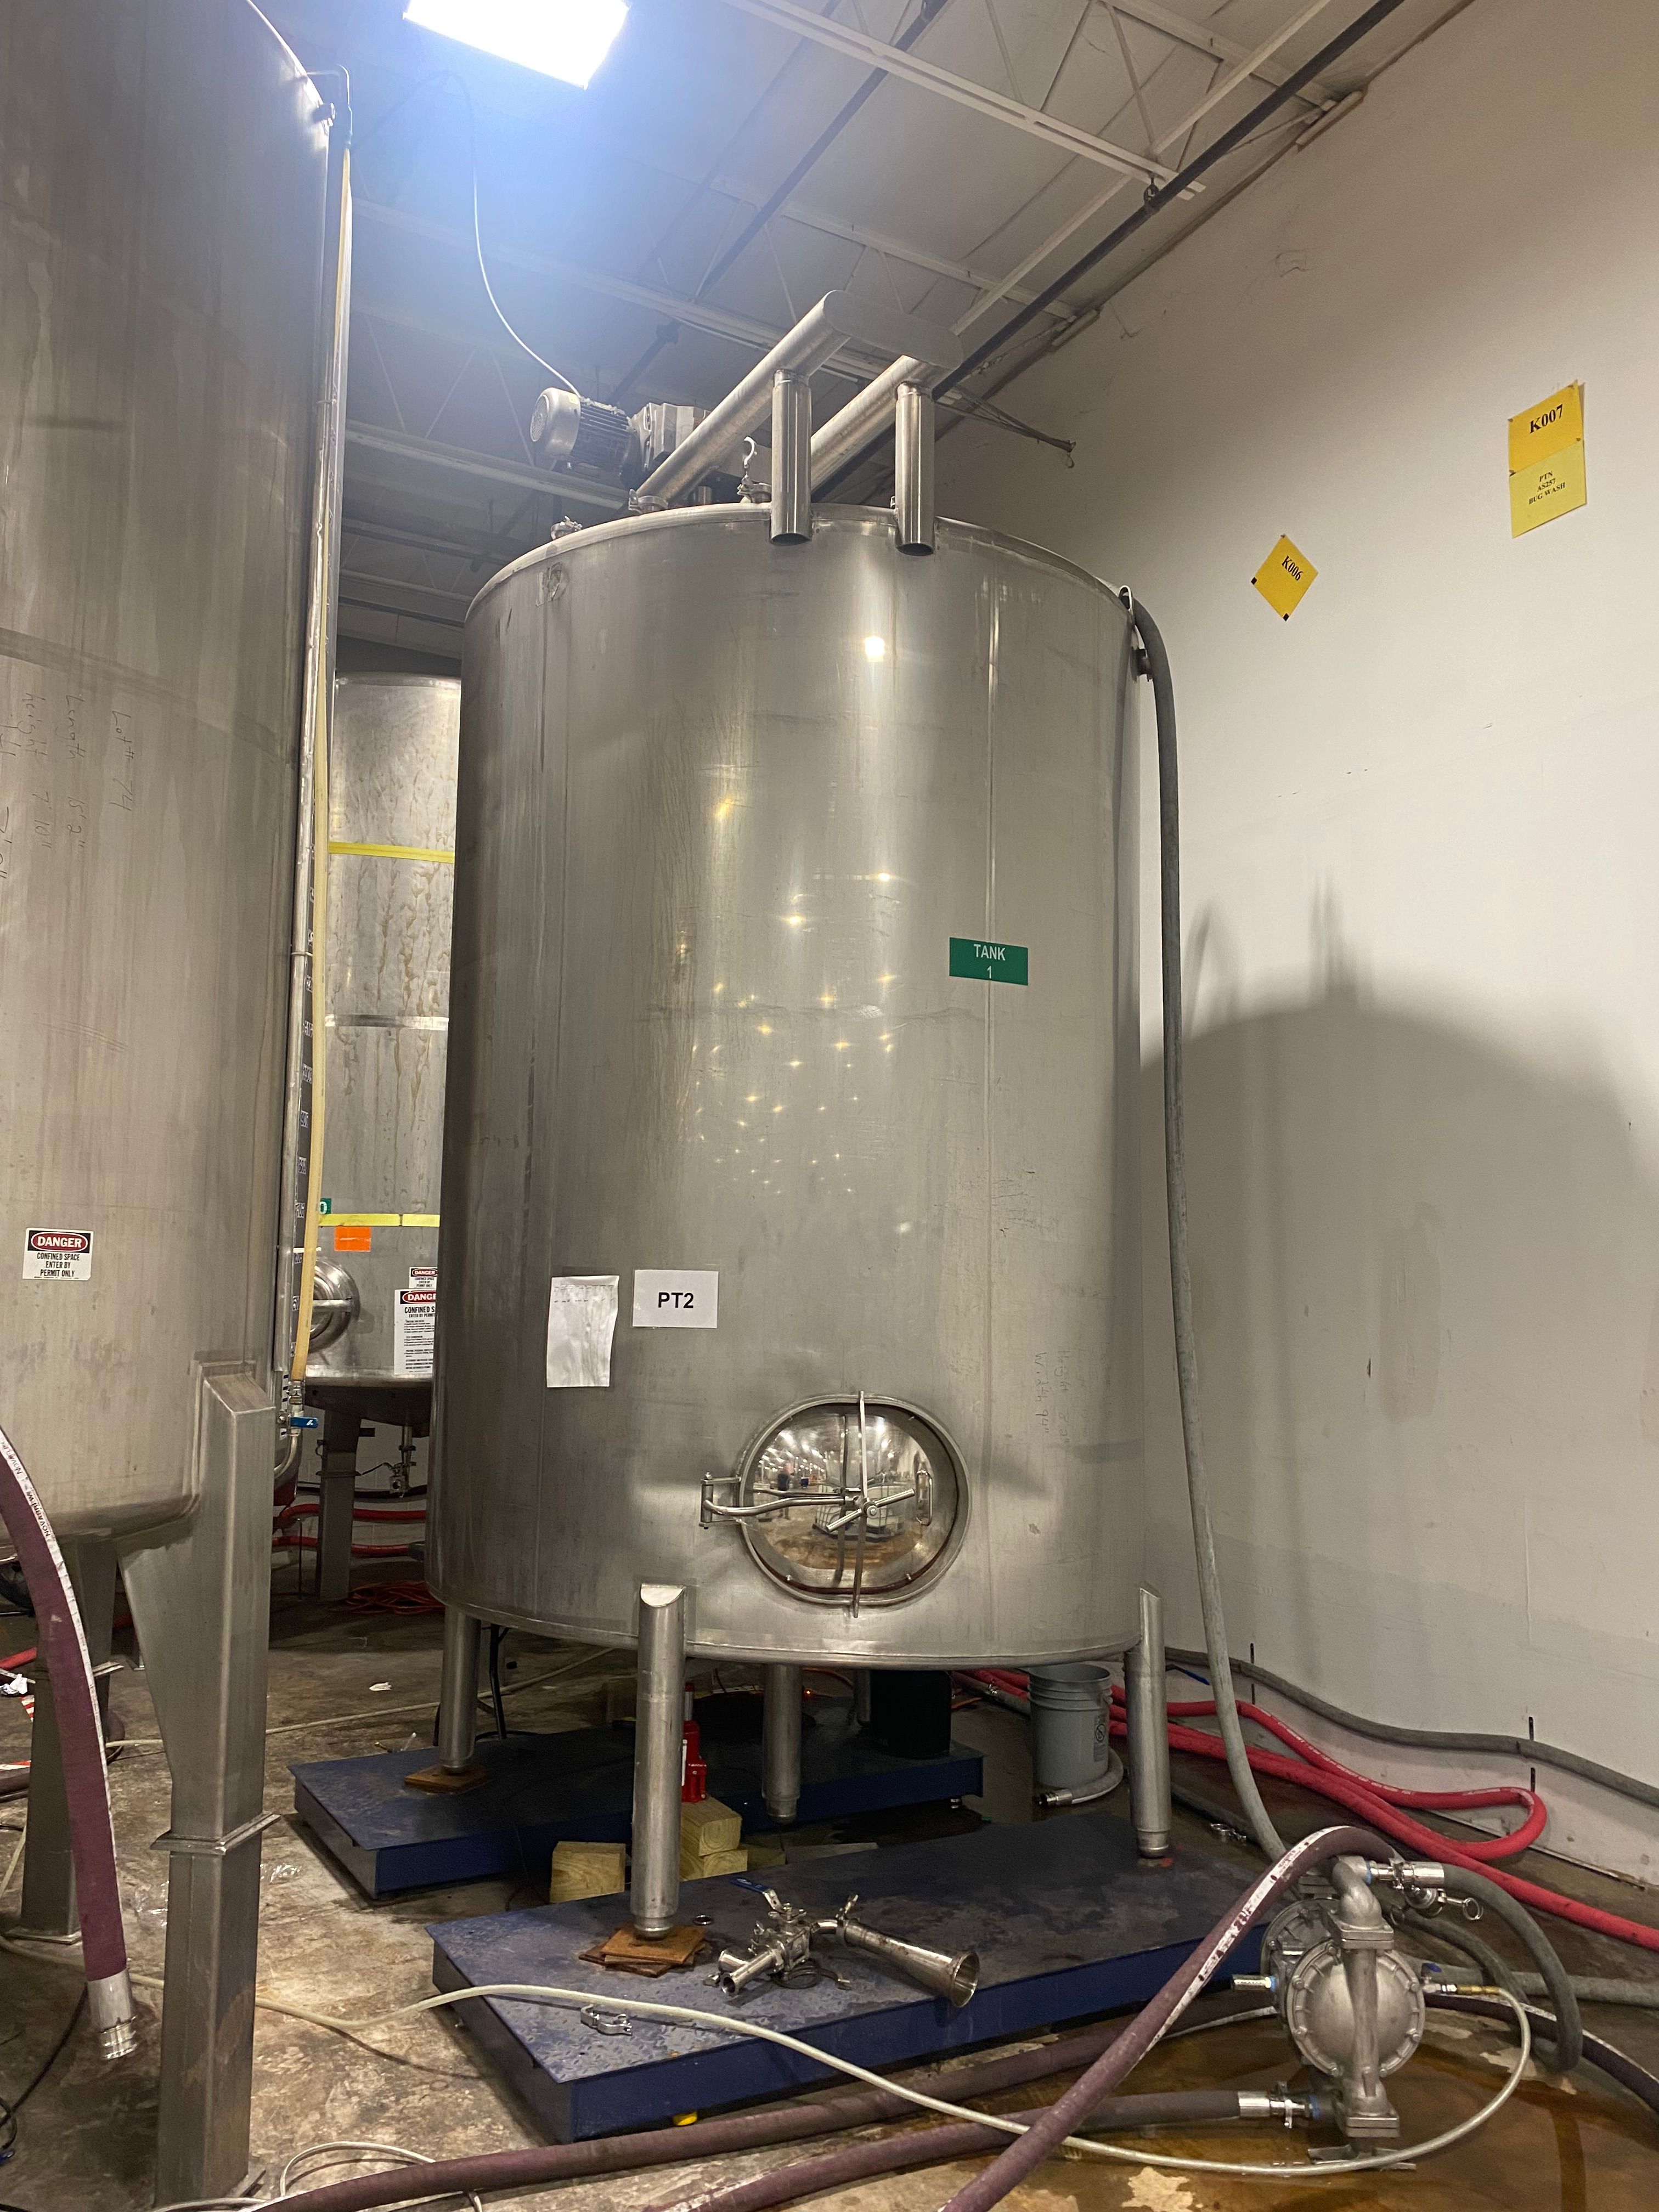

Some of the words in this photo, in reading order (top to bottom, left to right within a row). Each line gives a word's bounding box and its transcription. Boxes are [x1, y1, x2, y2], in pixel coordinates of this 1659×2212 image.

[1530, 404, 1563, 433] K007
[1539, 471, 1553, 482] PTN
[1529, 493, 1543, 504] BUG
[1544, 482, 1565, 495] WASH
[1282, 555, 1304, 581] K006
[974, 944, 1006, 961] TANK
[988, 966, 992, 979] 1
[37, 1236, 82, 1248] DANGER
[658, 1292, 695, 1308] PT2
